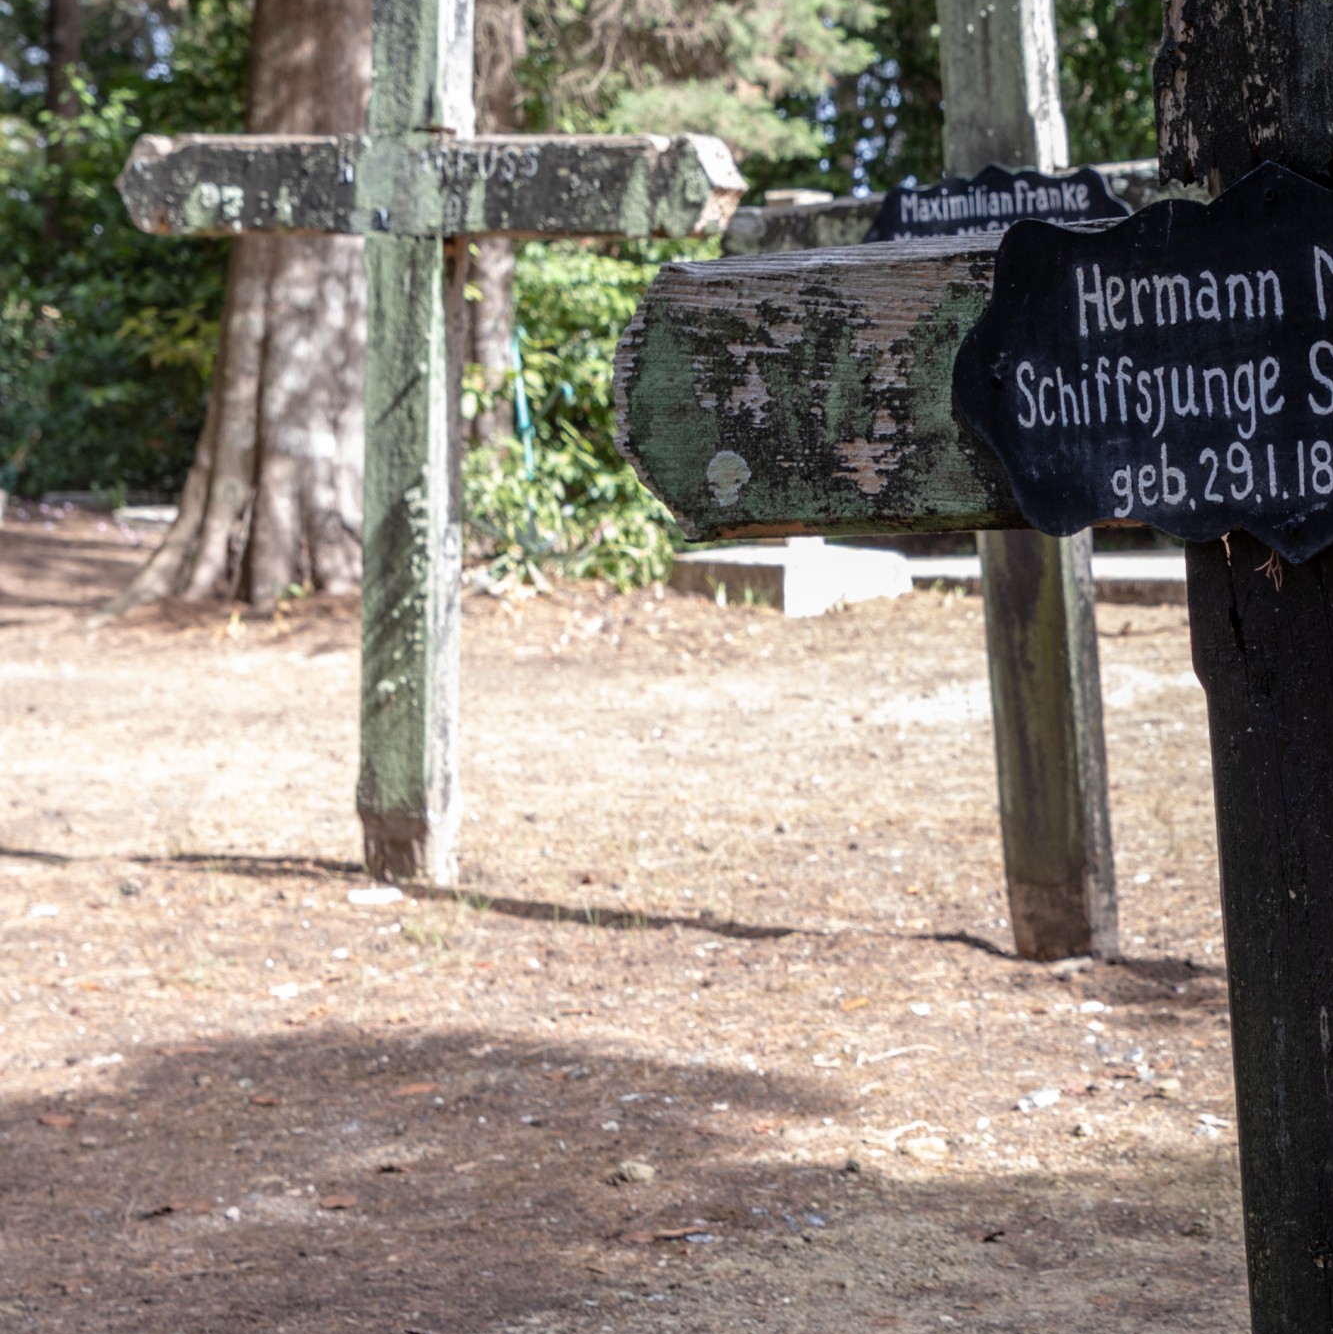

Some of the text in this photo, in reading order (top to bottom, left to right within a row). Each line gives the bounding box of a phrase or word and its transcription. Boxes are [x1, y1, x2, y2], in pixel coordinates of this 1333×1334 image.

[900, 180, 1090, 223] Maximilian Franke
[1075, 264, 1283, 338] Hermann
[1016, 356, 1285, 439] Schiffsjunge
